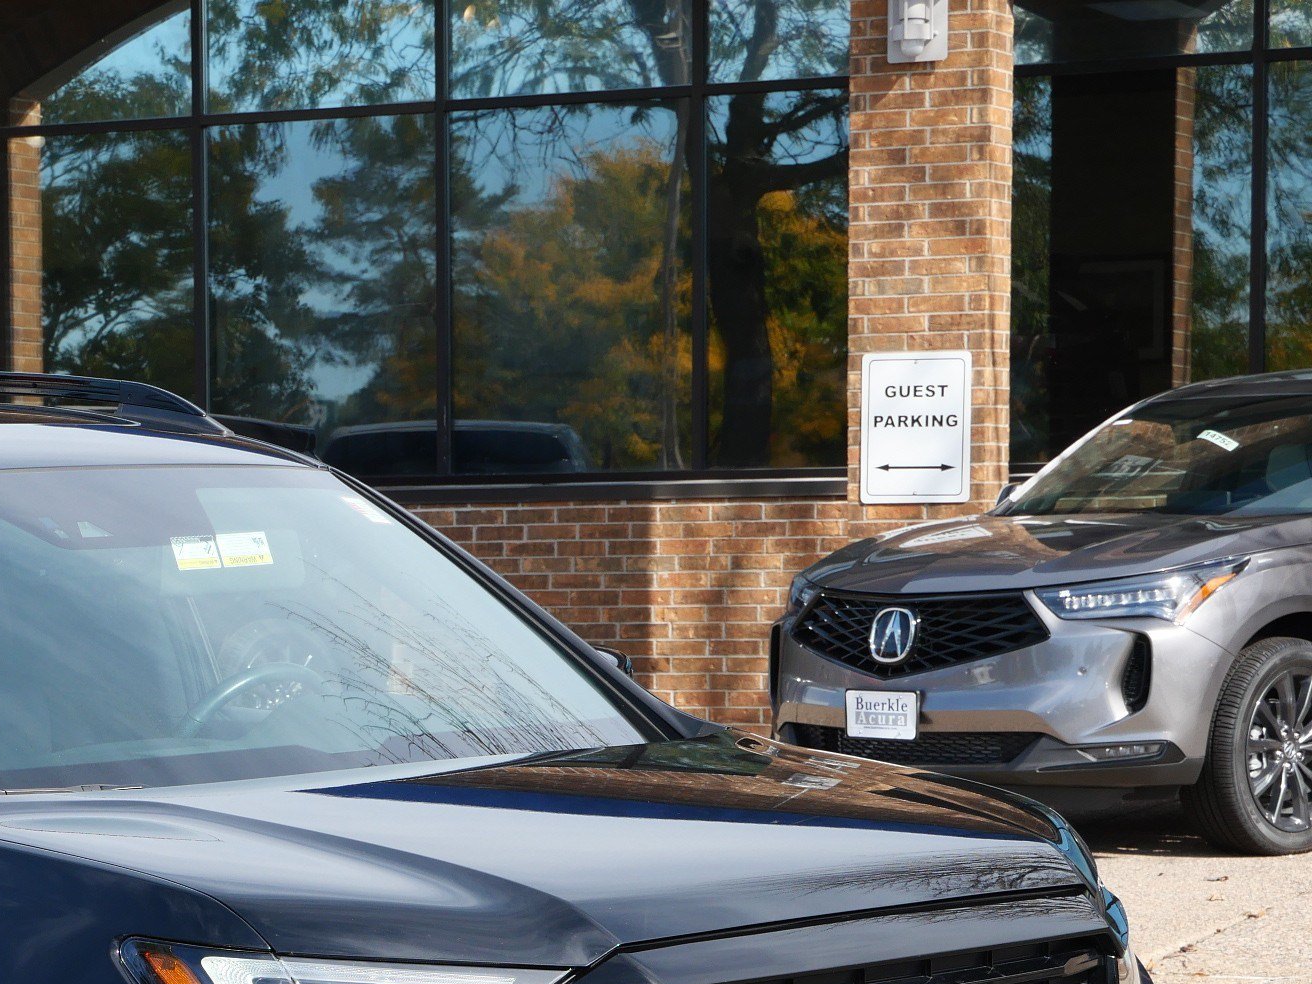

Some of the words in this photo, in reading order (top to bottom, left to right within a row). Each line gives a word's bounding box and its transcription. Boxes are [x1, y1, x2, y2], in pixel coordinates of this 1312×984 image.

[884, 384, 949, 398] GUEST
[873, 414, 959, 428] PARKING
[855, 697, 908, 712] Buerkle
[857, 712, 906, 726] Acura
